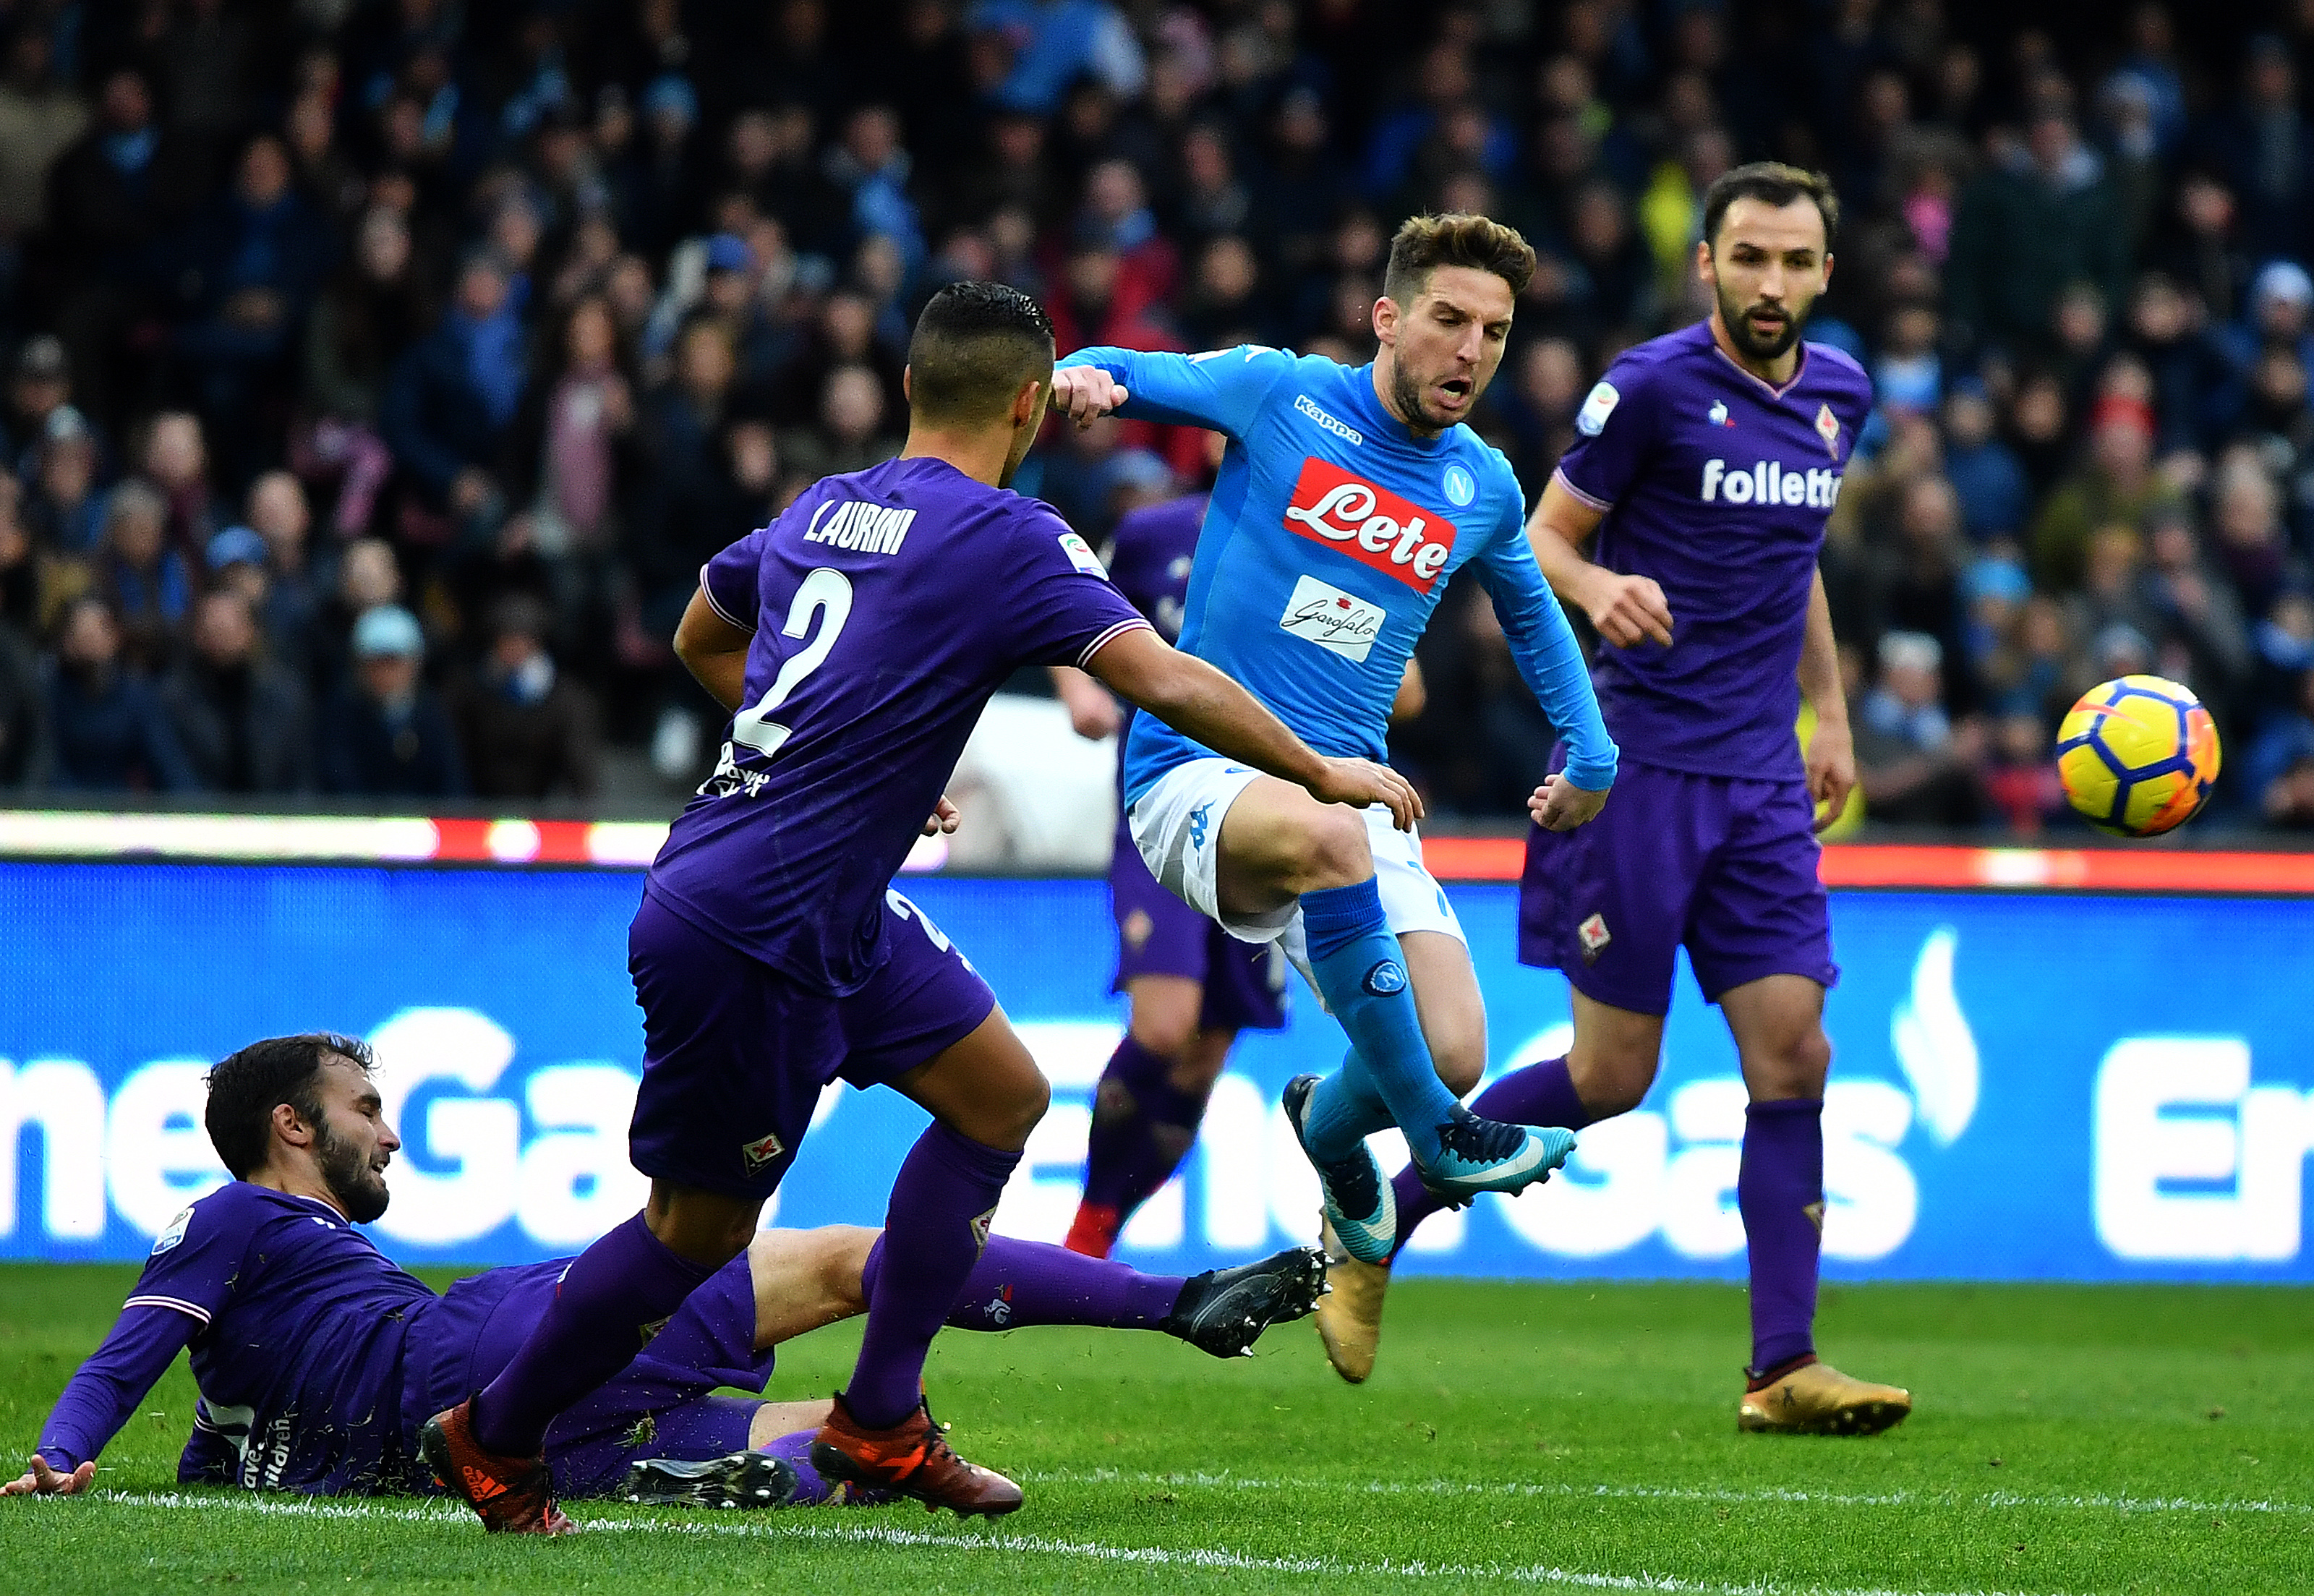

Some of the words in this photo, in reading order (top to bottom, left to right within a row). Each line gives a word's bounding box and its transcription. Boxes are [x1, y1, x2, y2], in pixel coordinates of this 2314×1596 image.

[1294, 394, 1363, 445] Kappa
[1448, 471, 1467, 499] N
[803, 500, 918, 555] LAURINI
[1286, 483, 1449, 580] Lete
[1280, 599, 1377, 644] Garofalo
[733, 567, 853, 759] 2
[885, 889, 950, 953] 2
[1378, 968, 1401, 989] N
[244, 1449, 263, 1490] ave
[265, 1414, 291, 1488] ildren
